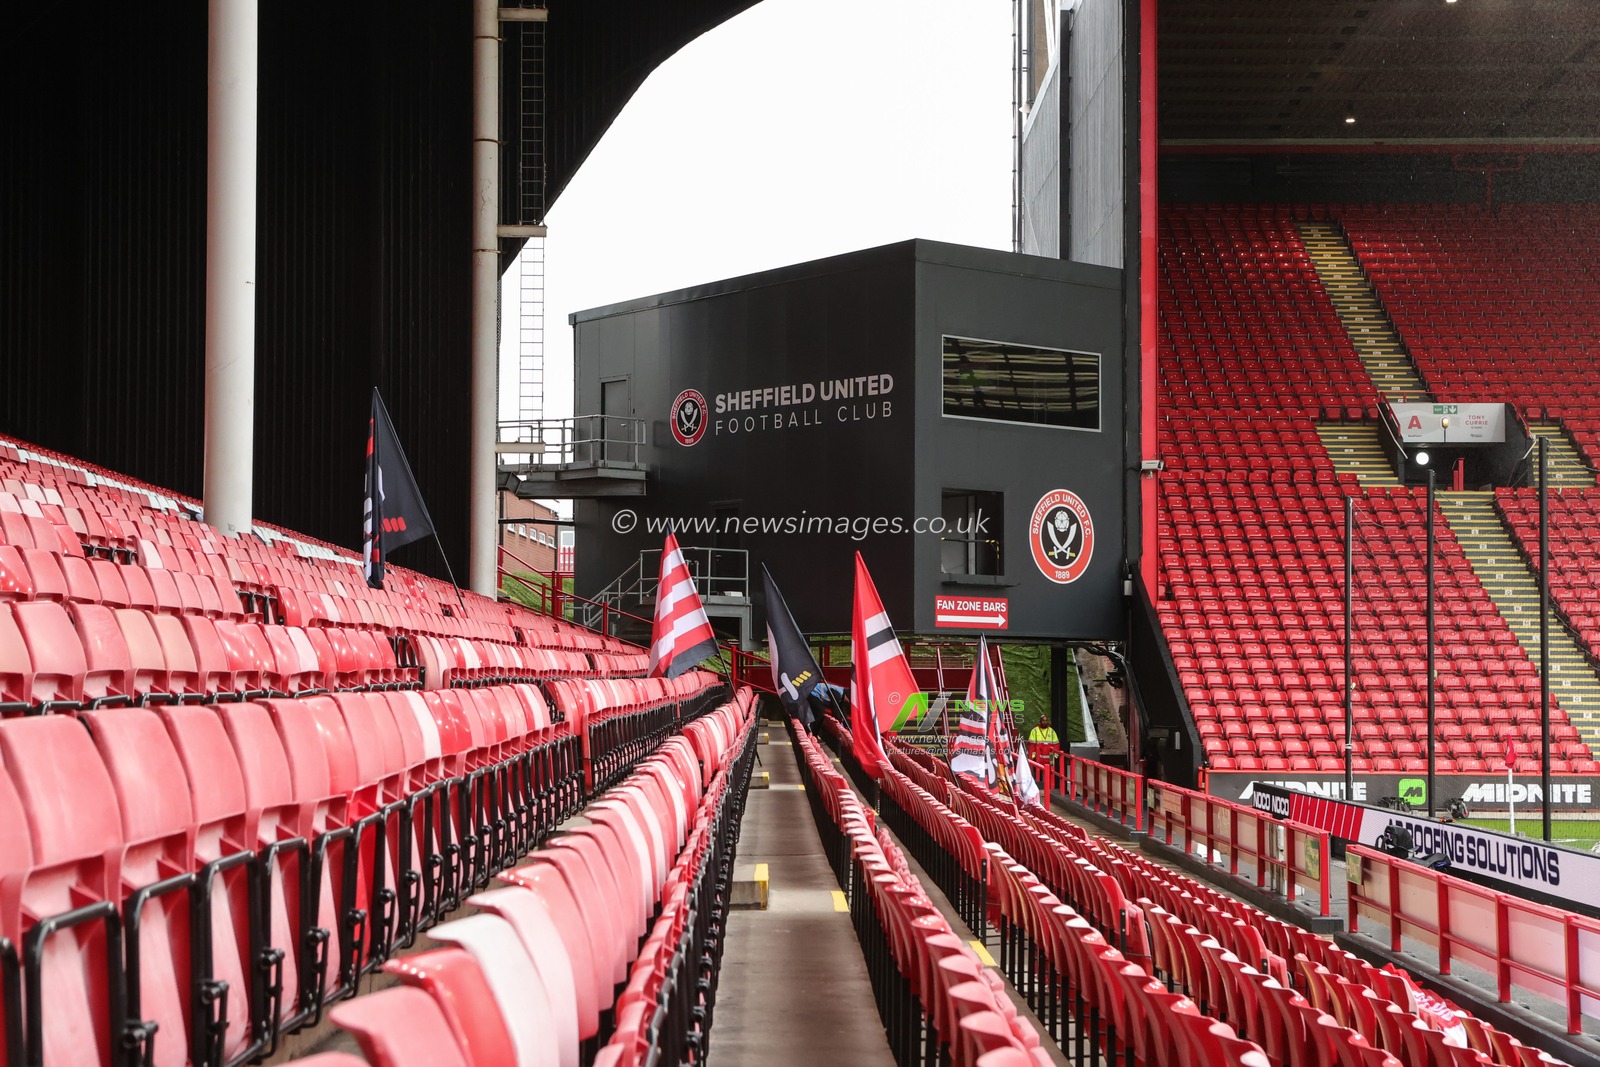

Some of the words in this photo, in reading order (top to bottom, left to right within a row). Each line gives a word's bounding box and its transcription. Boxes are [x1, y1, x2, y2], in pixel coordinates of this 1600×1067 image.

[715, 383, 815, 414] SHEFFIELD
[820, 373, 894, 401] UNITED
[715, 409, 822, 436] FOOTBALL
[837, 401, 892, 423] CLUB
[1408, 415, 1423, 430] A
[1033, 494, 1061, 535] SHEFFIELD
[1062, 493, 1086, 518] UNITED
[1083, 520, 1091, 538] F.C.
[1055, 570, 1070, 579] 1889
[937, 599, 955, 611] FAN
[957, 600, 981, 612] ZONE
[983, 602, 1006, 613] BARS
[1253, 790, 1270, 811] NOCO
[1272, 795, 1290, 816] NOCO
[1460, 783, 1592, 804] MIDNITE
[1467, 834, 1560, 886] SOLUTIONS
